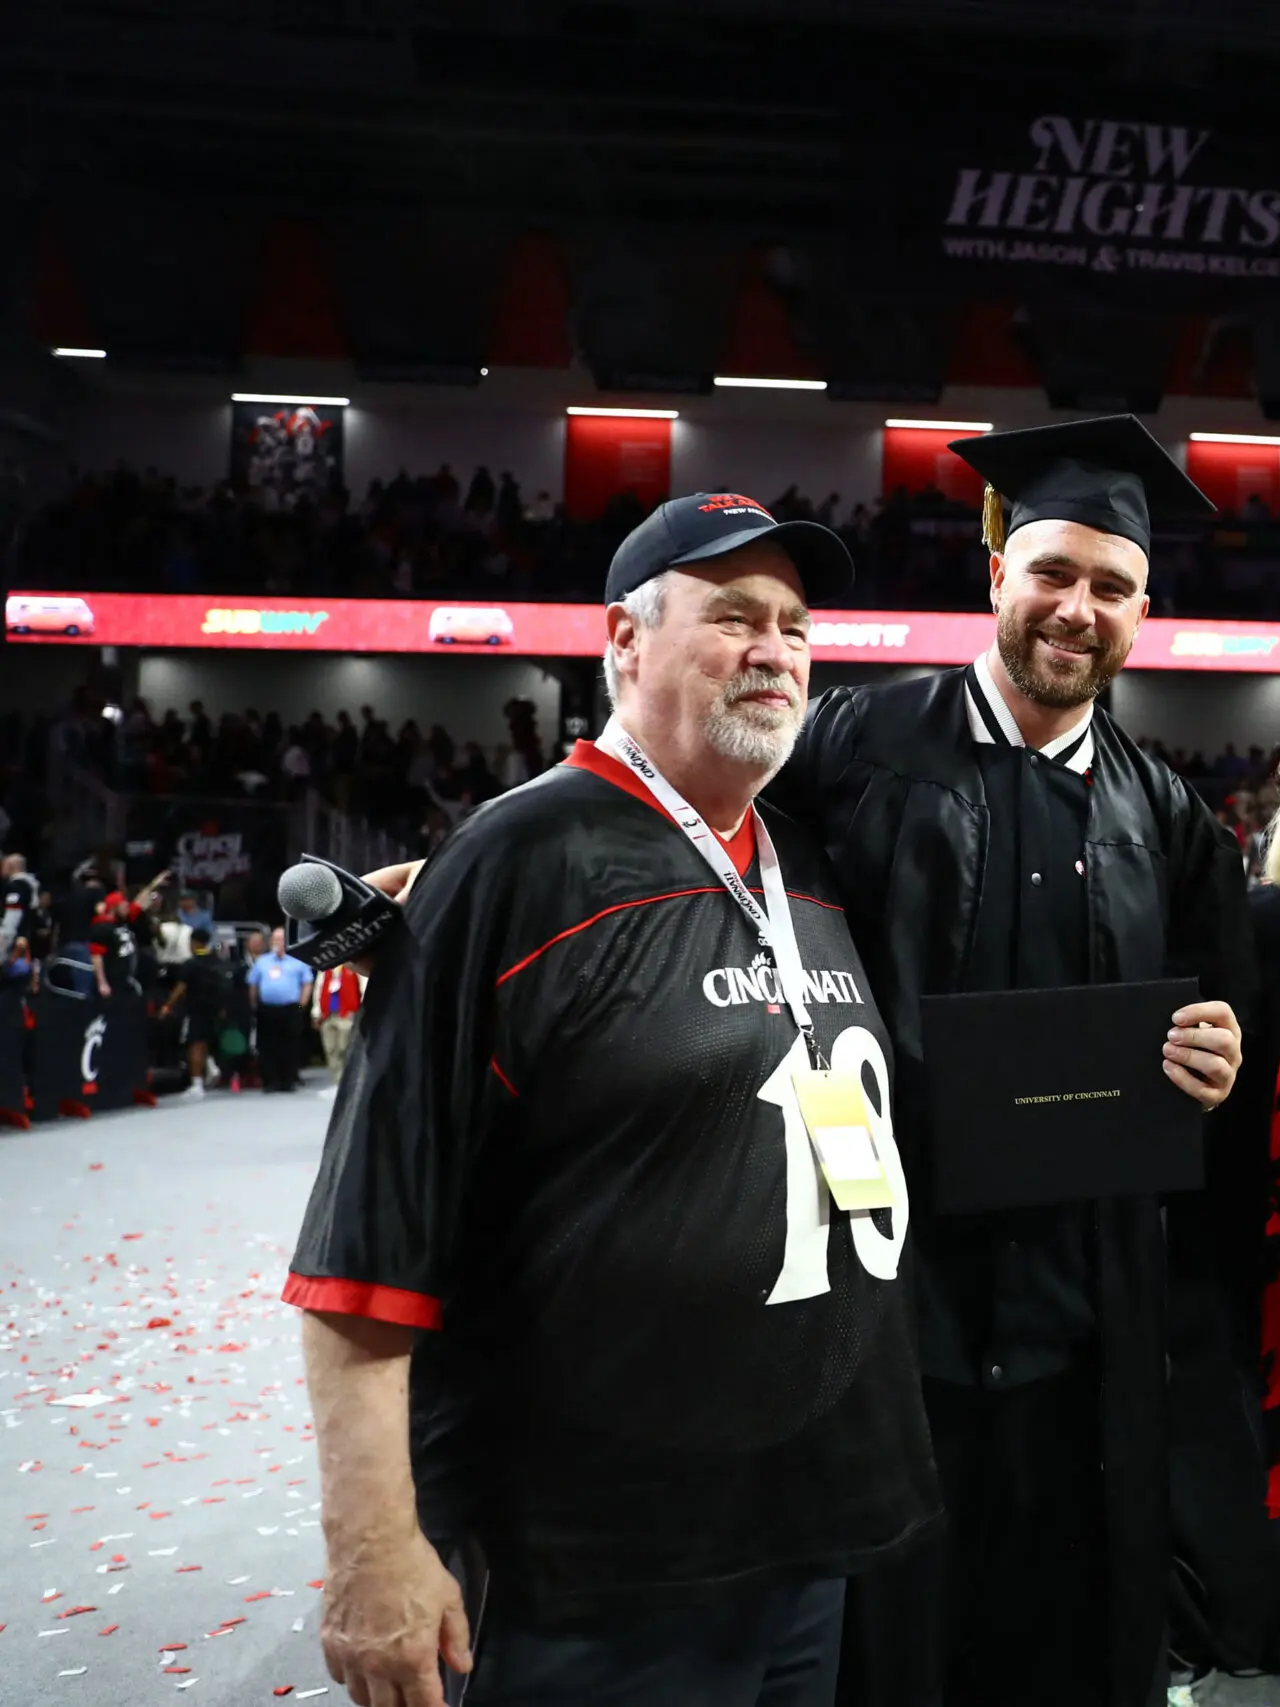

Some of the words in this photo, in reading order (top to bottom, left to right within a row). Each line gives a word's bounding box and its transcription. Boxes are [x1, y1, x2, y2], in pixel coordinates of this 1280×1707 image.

[1029, 114, 1211, 180] NEW
[942, 237, 1006, 259] WITH
[1008, 240, 1088, 266] JASON
[1091, 244, 1121, 273] &
[1126, 248, 1206, 272] TRAVIS
[201, 608, 329, 635] SUBWAY
[615, 738, 655, 778] CINCINNATI
[722, 870, 761, 920] CINCINNATI
[702, 964, 864, 1008] CINCINATI
[1015, 1094, 1061, 1104] UNIVERSITY
[1062, 1093, 1074, 1101] OF
[1074, 1089, 1121, 1100] CINCINNATI
